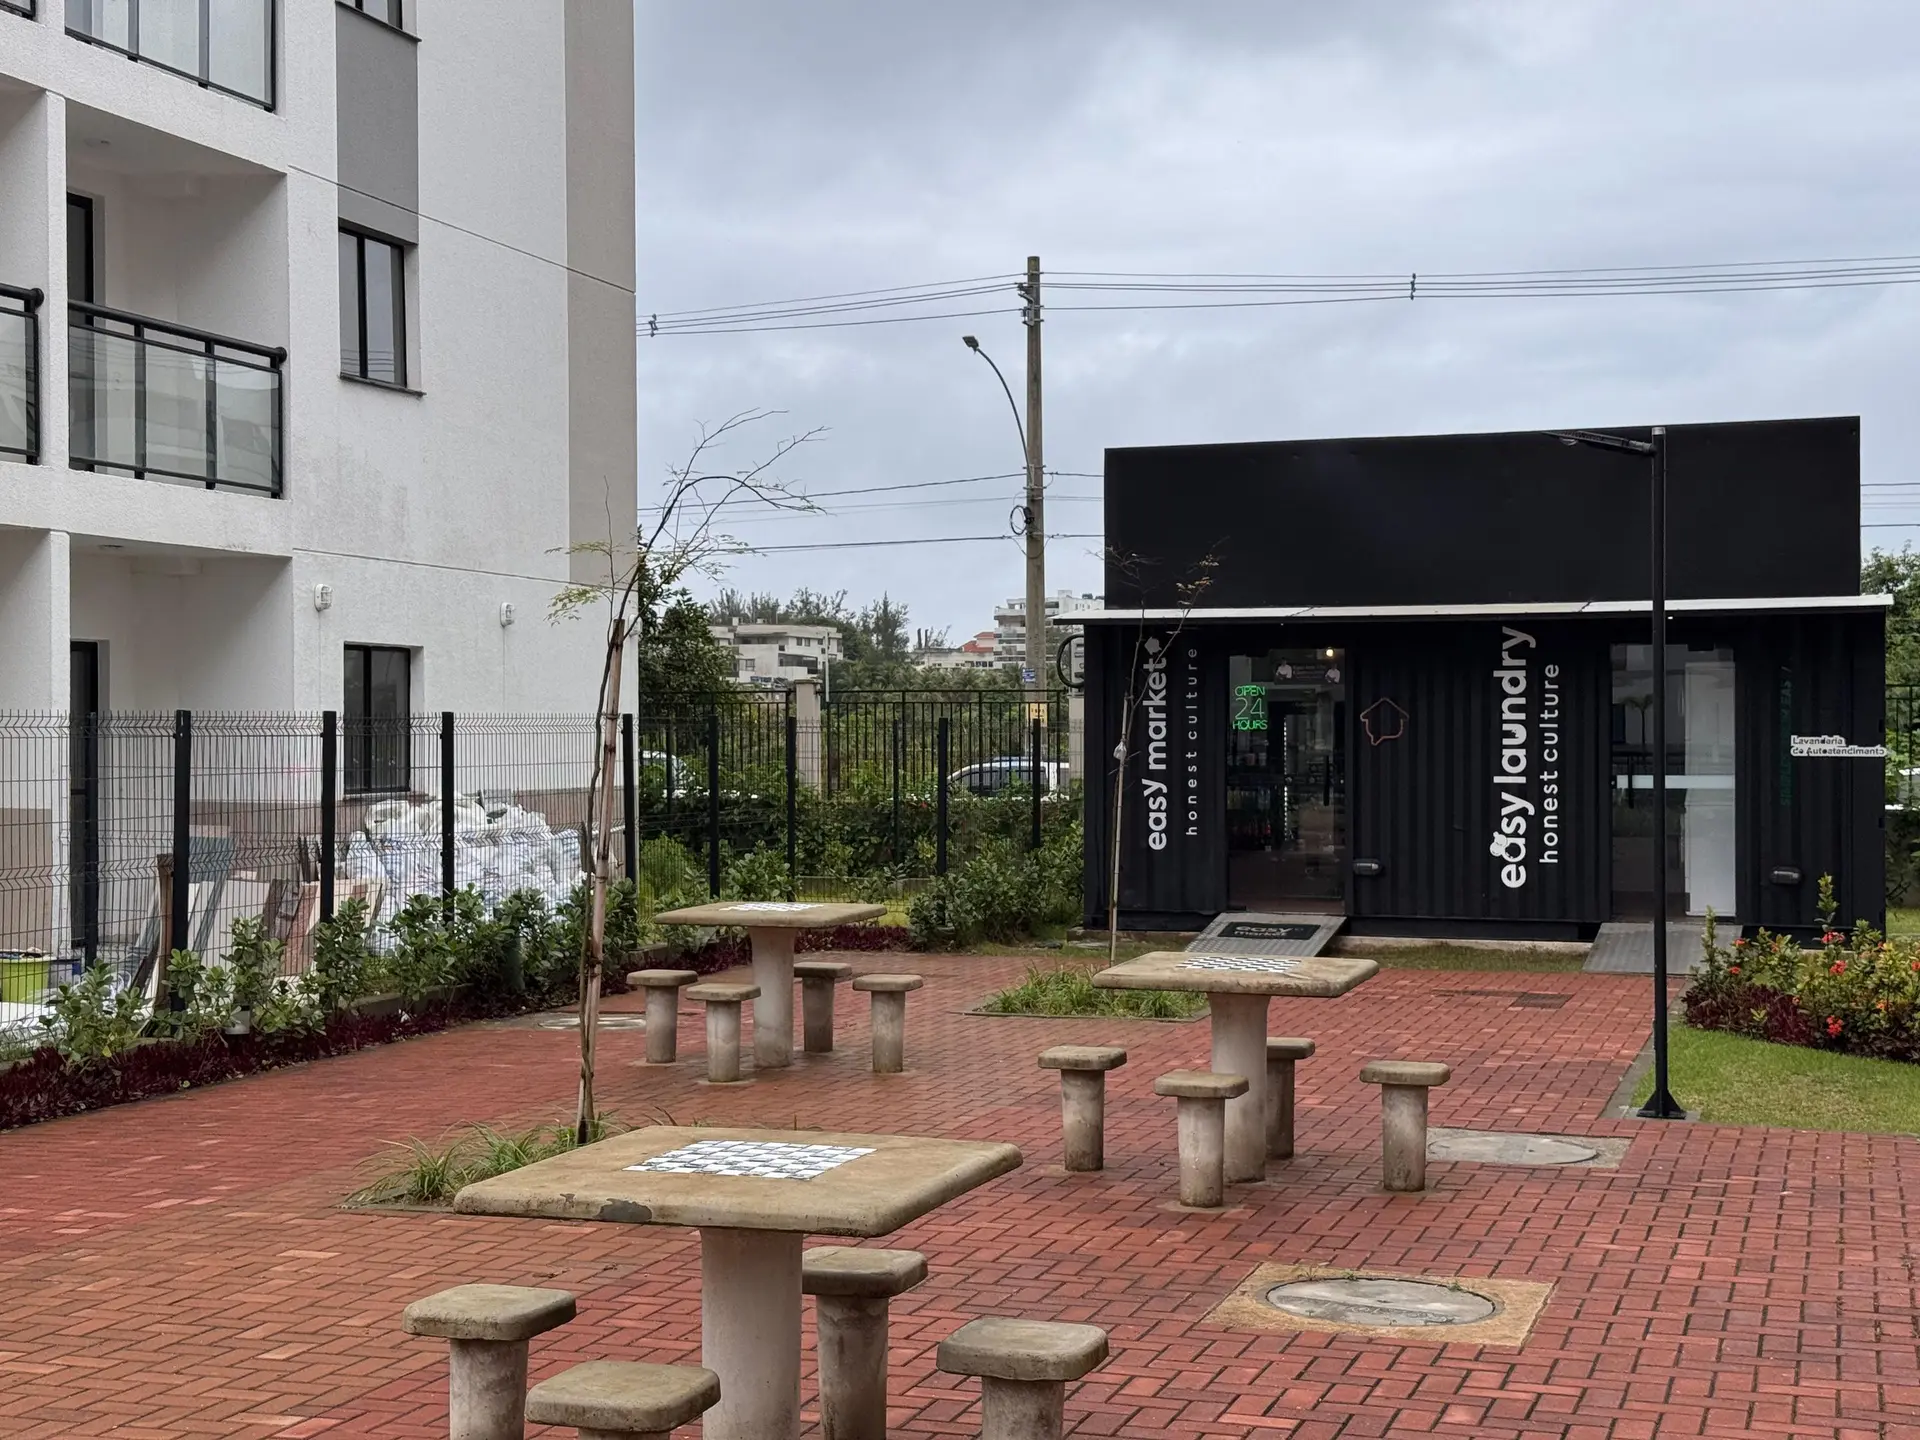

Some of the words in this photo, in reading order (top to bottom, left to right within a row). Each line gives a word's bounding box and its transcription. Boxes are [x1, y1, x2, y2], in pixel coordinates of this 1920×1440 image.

[1141, 657, 1168, 770] market
[1185, 648, 1198, 741] culture
[1232, 719, 1268, 730] HOURS
[1234, 685, 1266, 697] OPEN
[1234, 697, 1265, 720] 24
[1492, 626, 1536, 784] laundry
[1538, 664, 1560, 763] culture
[1141, 778, 1168, 851] easy
[1185, 750, 1198, 836] honest
[1538, 770, 1559, 864] honest
[1489, 791, 1536, 889] easy
[1235, 925, 1293, 933] easy
